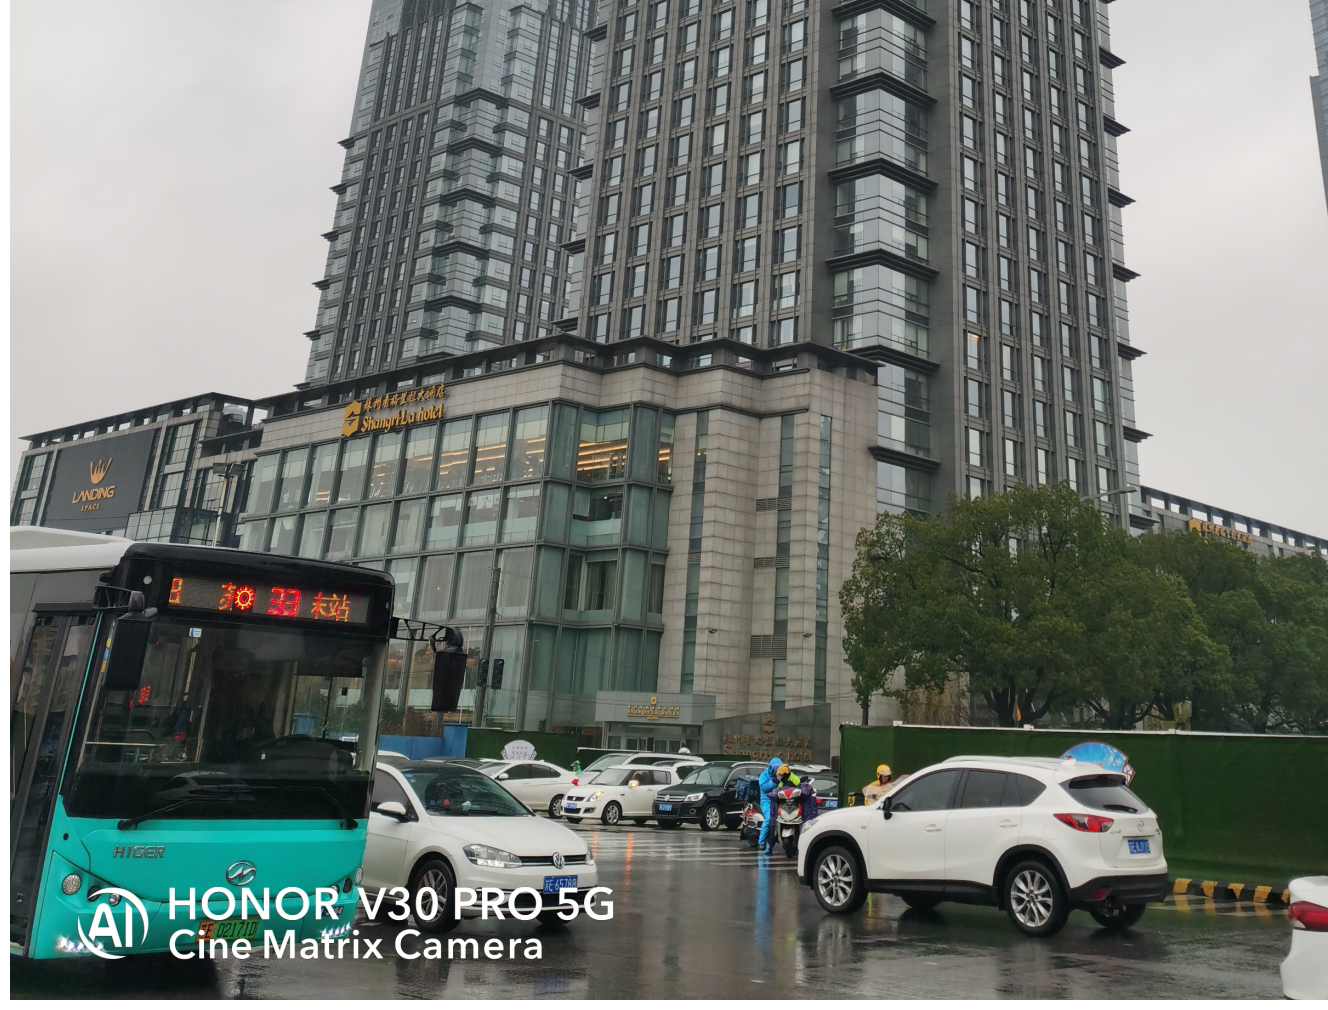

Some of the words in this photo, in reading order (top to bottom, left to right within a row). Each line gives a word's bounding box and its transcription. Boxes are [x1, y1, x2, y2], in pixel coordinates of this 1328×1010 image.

[361, 409, 415, 433] Shangri-La
[417, 403, 444, 422] hotel
[72, 485, 115, 504] LANDING
[81, 503, 100, 512] SPACE
[112, 845, 165, 859] HIGER
